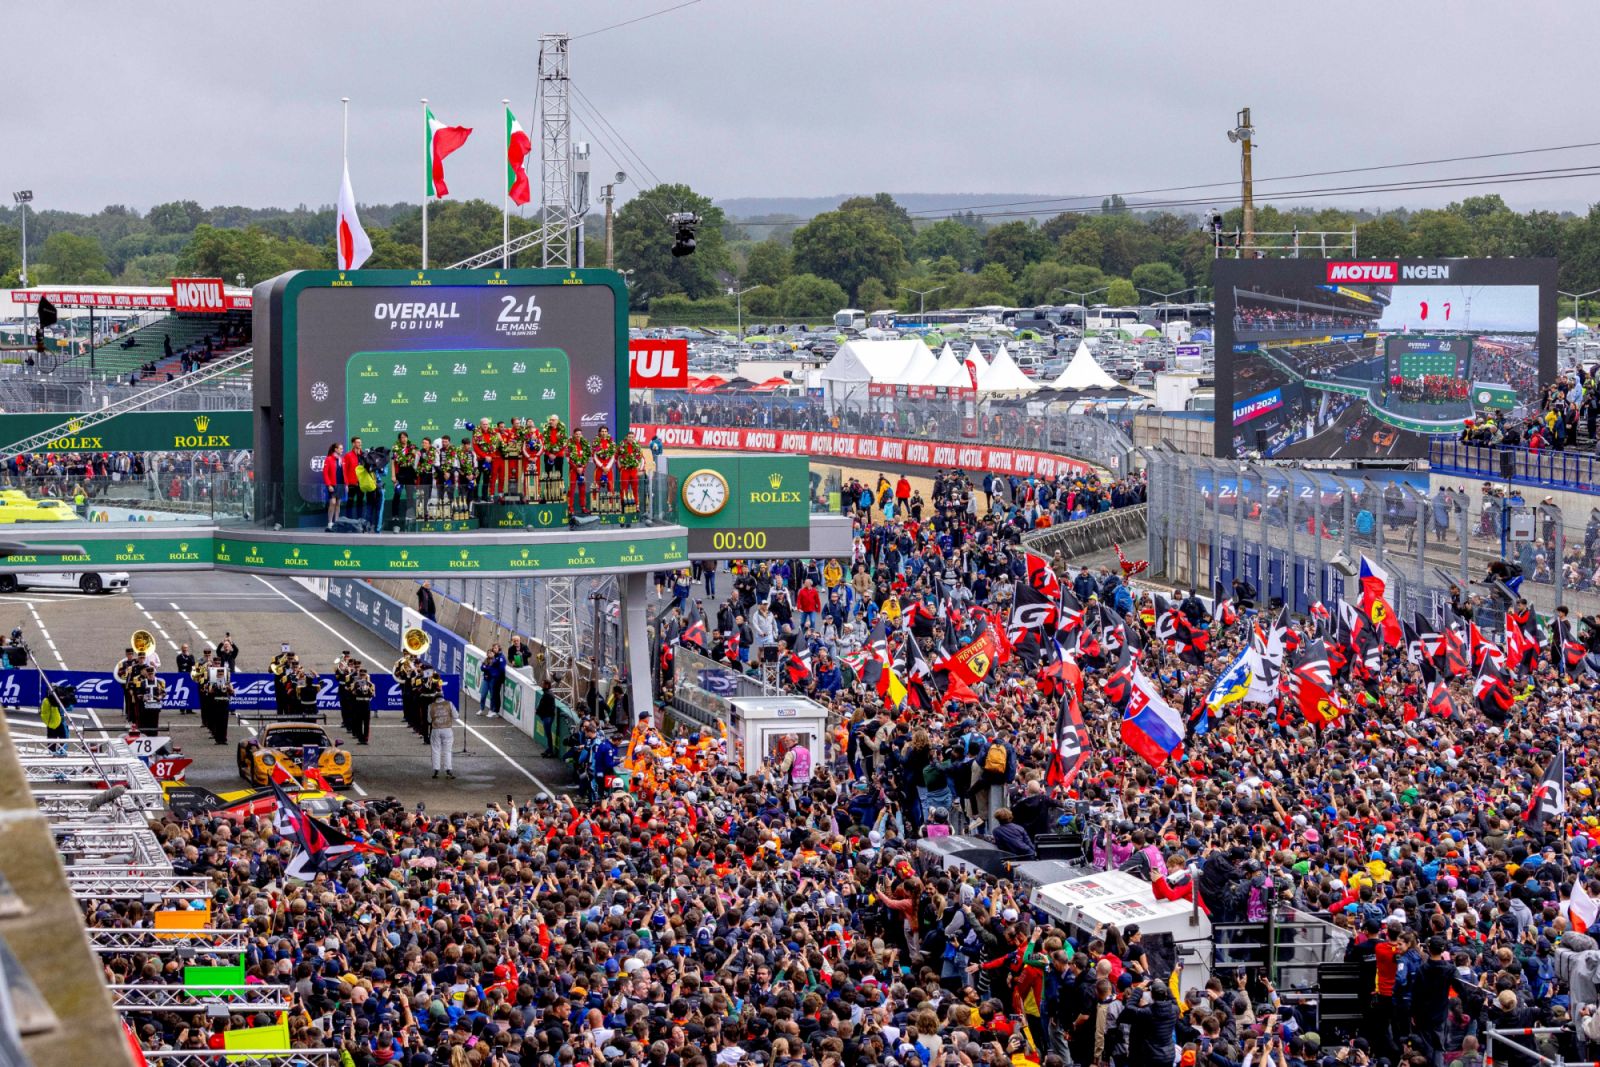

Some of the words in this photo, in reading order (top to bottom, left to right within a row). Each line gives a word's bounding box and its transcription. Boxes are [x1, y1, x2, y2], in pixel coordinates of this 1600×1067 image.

[1330, 266, 1394, 279] MOTUL
[1402, 266, 1449, 279] NGEN
[133, 296, 149, 305] MOTUL
[151, 296, 167, 306] MOTUL
[176, 283, 223, 308] MOTUL
[233, 298, 251, 307] MOTUL
[374, 302, 460, 319] OVERALL
[497, 295, 542, 322] 24h
[390, 320, 444, 329] PODIUM
[1233, 404, 1255, 420] JUIN
[1256, 396, 1277, 409] 2024
[306, 420, 335, 429] WEC
[581, 412, 608, 421] WEC
[48, 438, 103, 449] ROLEX
[175, 436, 230, 447] ROLEX
[656, 428, 694, 444] MOTUL
[702, 430, 739, 446] MOTUL
[746, 432, 775, 448] MOTUL
[781, 435, 806, 450] MOTUL
[812, 435, 832, 451] MOTUL
[833, 437, 854, 454] MOTUL
[859, 439, 877, 456] MOTUL
[881, 440, 903, 459] MOTUL
[907, 444, 928, 463] MOTUL
[934, 446, 956, 465] MOTUL
[959, 449, 983, 467] MOTUL
[988, 451, 1012, 470] MOTUL
[1015, 454, 1035, 472] MOTUL
[751, 492, 801, 503] ROLEX
[713, 532, 766, 549] 00:00
[136, 740, 152, 752] 78
[156, 762, 174, 776] 87
